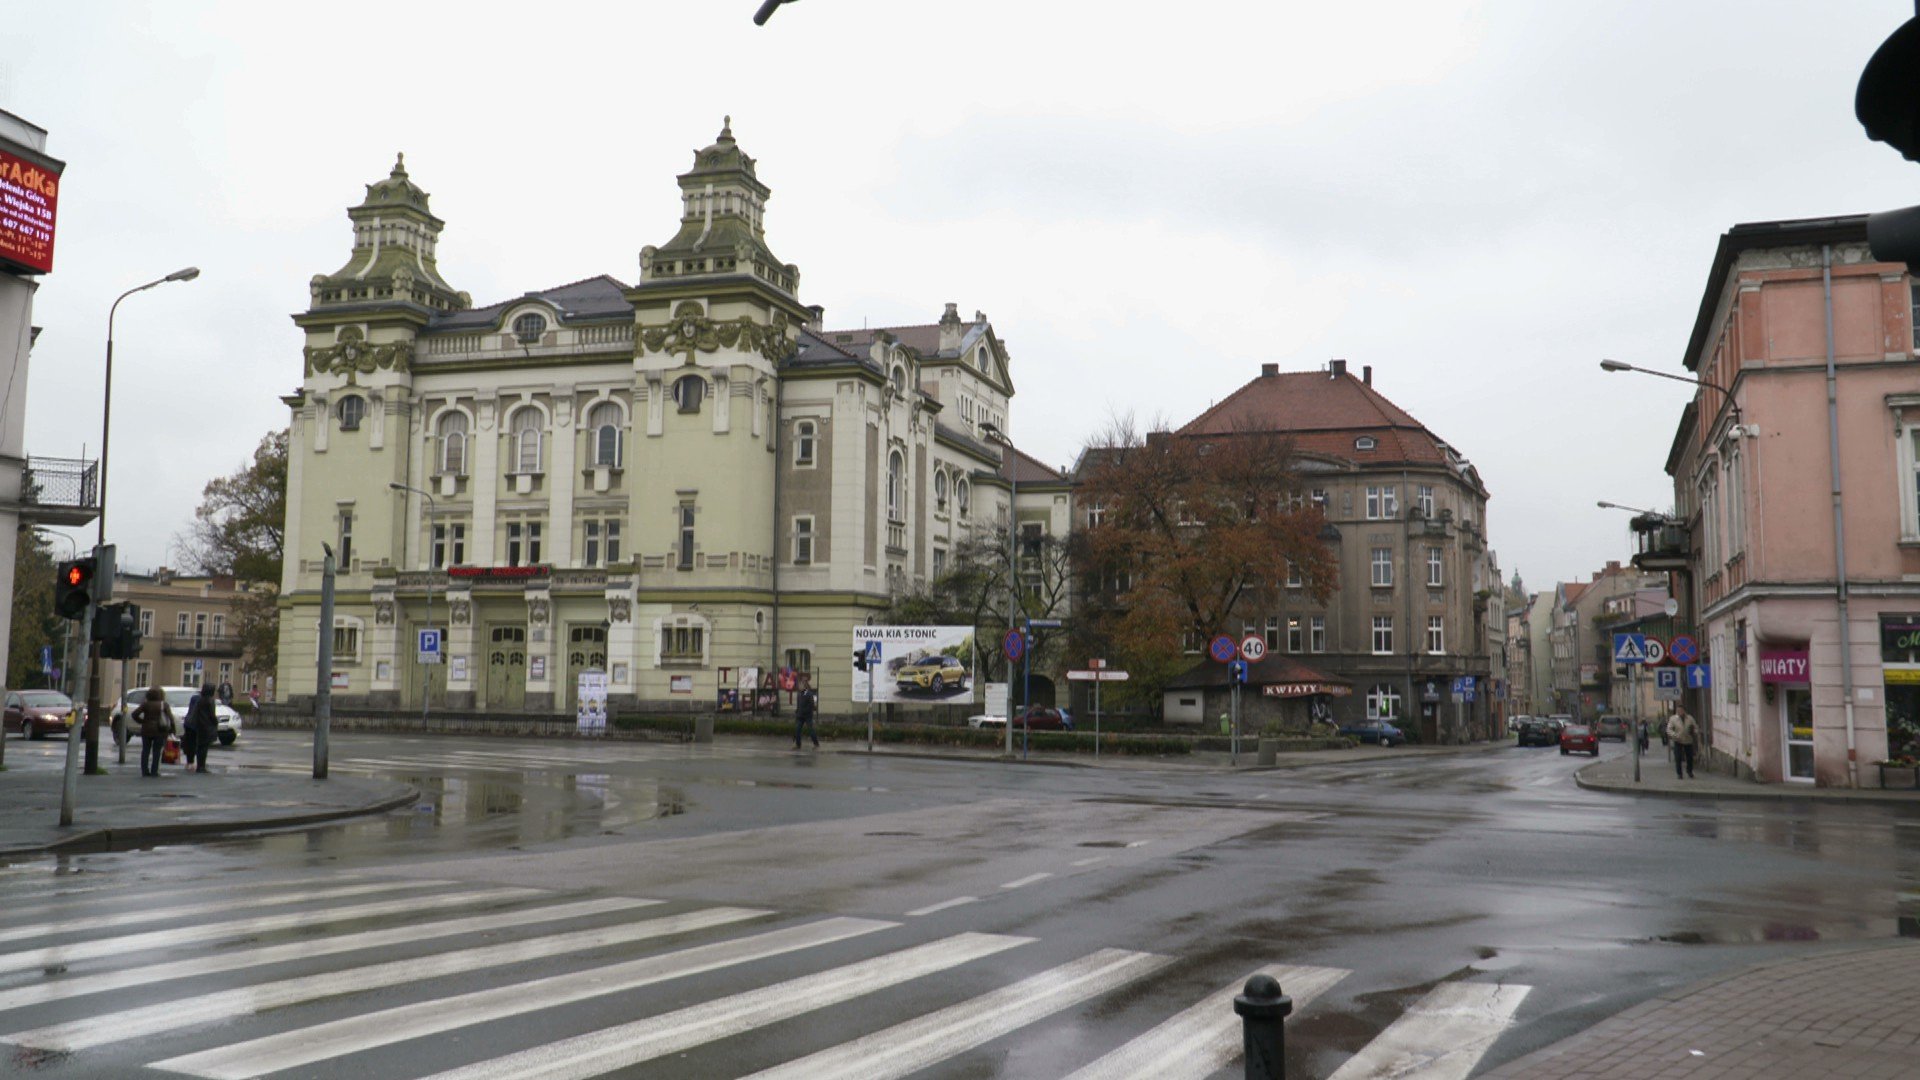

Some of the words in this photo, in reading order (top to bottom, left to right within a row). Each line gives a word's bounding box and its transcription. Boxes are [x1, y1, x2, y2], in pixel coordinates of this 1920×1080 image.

[0, 162, 56, 198] rAdKa
[856, 629, 884, 638] NOWA
[886, 629, 902, 638] KIA
[904, 629, 937, 638] STONIC
[1243, 641, 1263, 655] 40
[1761, 658, 1806, 675] KWIATY
[1266, 684, 1317, 695] KWIATY
